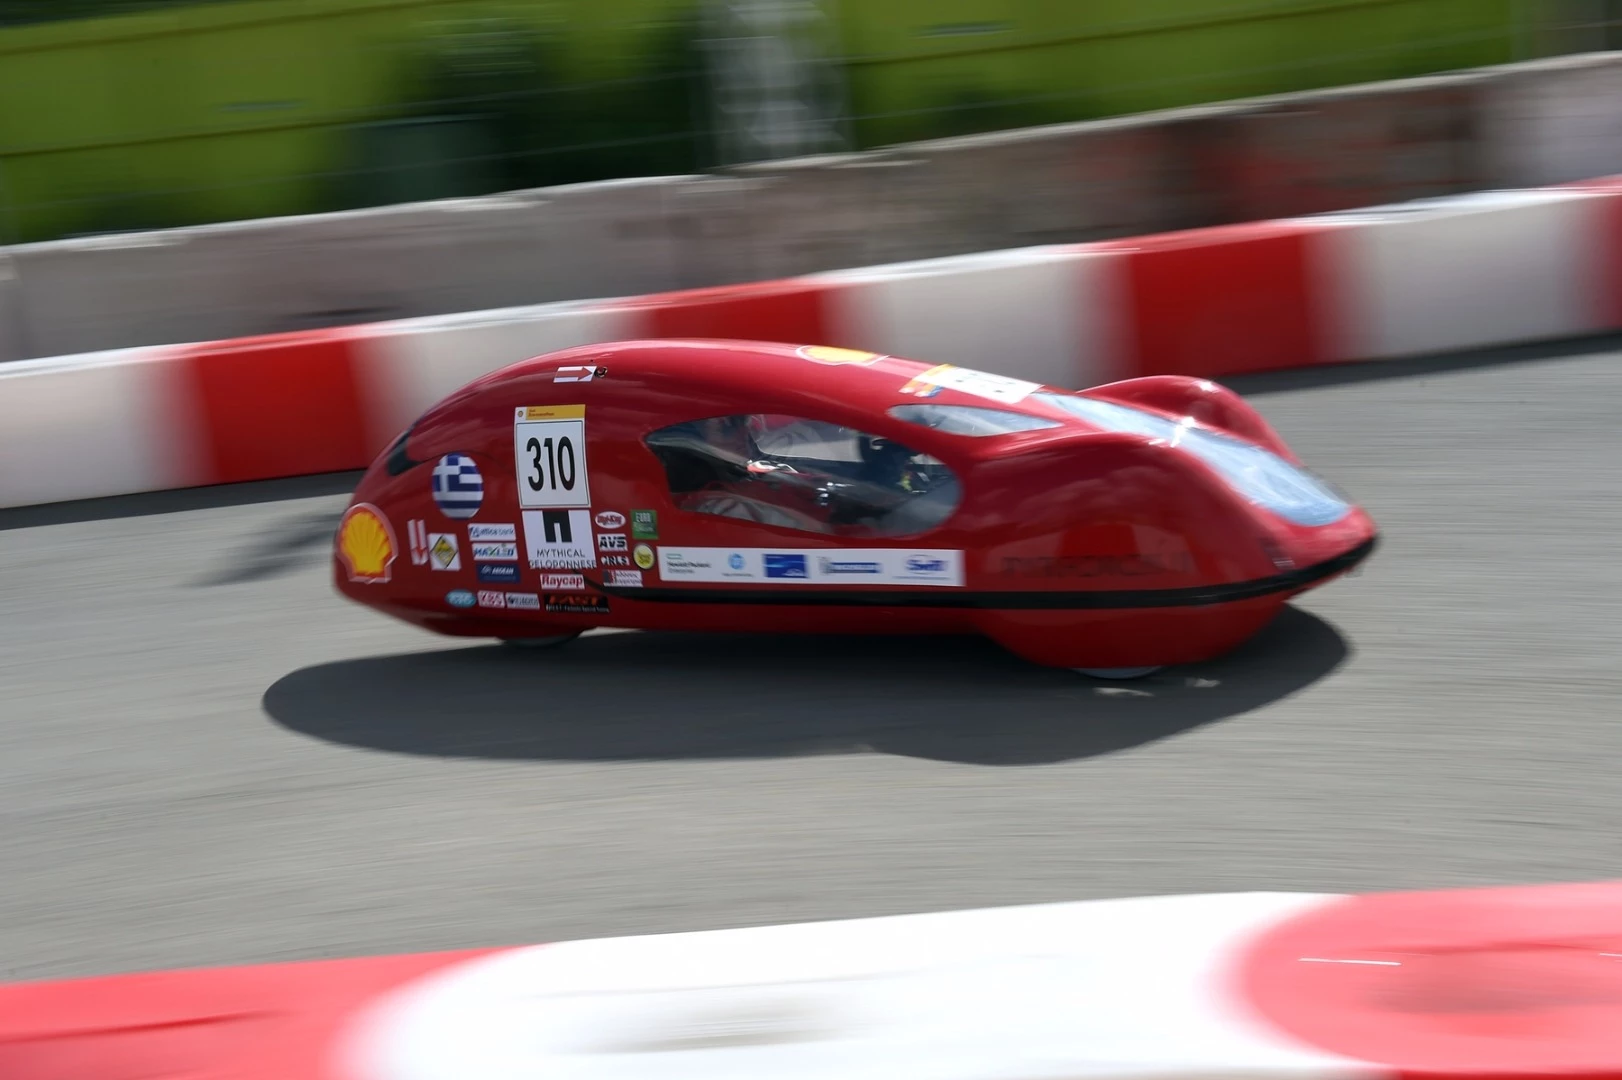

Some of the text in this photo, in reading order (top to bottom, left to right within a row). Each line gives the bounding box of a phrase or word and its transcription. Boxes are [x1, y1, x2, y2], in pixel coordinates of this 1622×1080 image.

[526, 436, 576, 492] 310
[600, 536, 626, 548] AVS
[536, 548, 586, 558] MYTHICAL
[541, 574, 583, 589] Raycap
